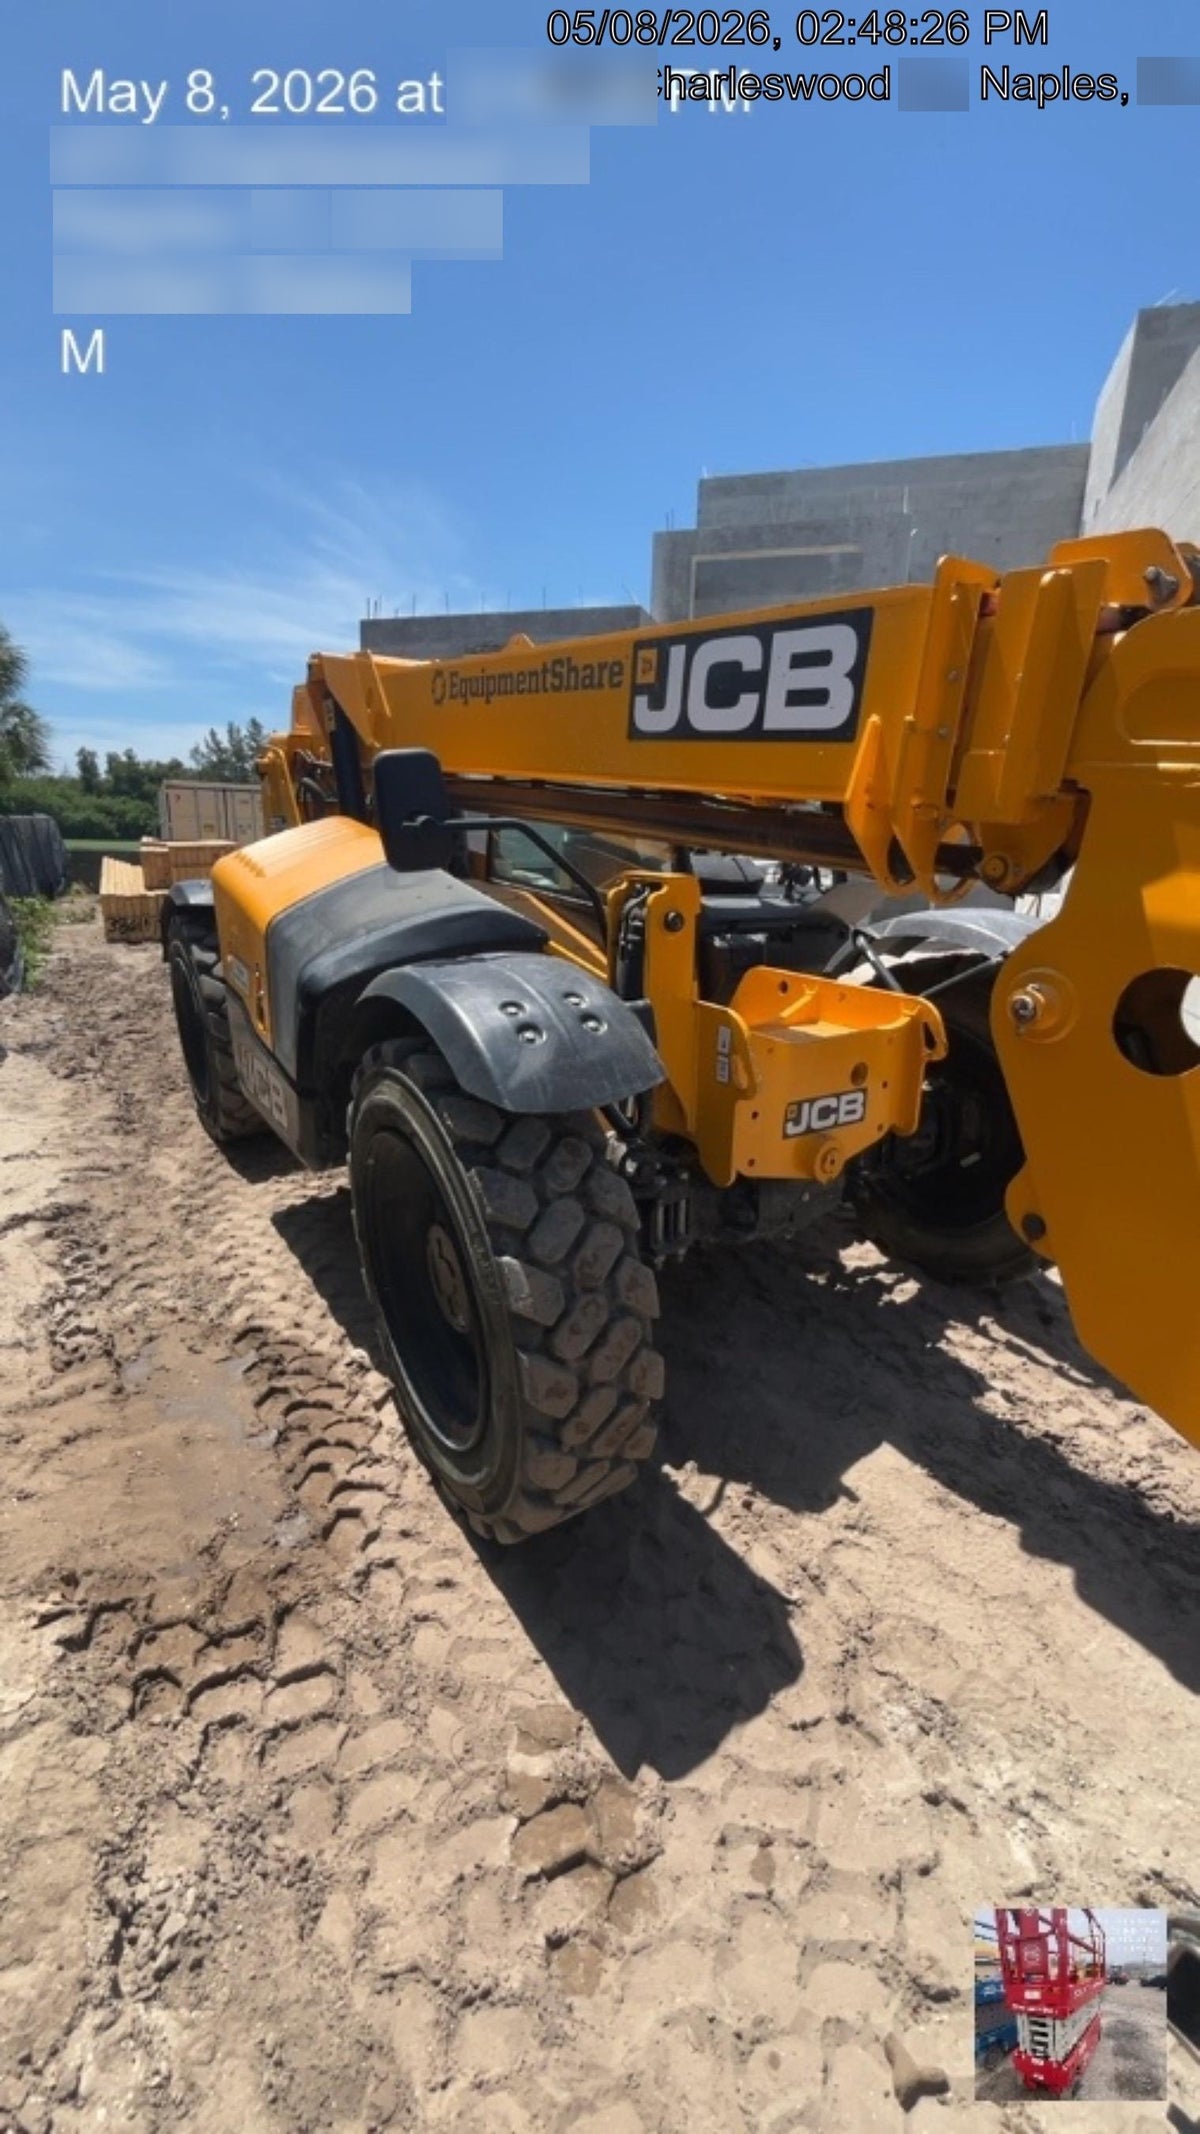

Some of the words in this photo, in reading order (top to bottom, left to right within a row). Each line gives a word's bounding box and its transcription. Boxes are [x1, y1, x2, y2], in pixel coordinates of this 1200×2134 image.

[448, 656, 625, 704] EquipmentShare
[633, 624, 858, 732] JCB
[786, 1091, 864, 1135] JCB
